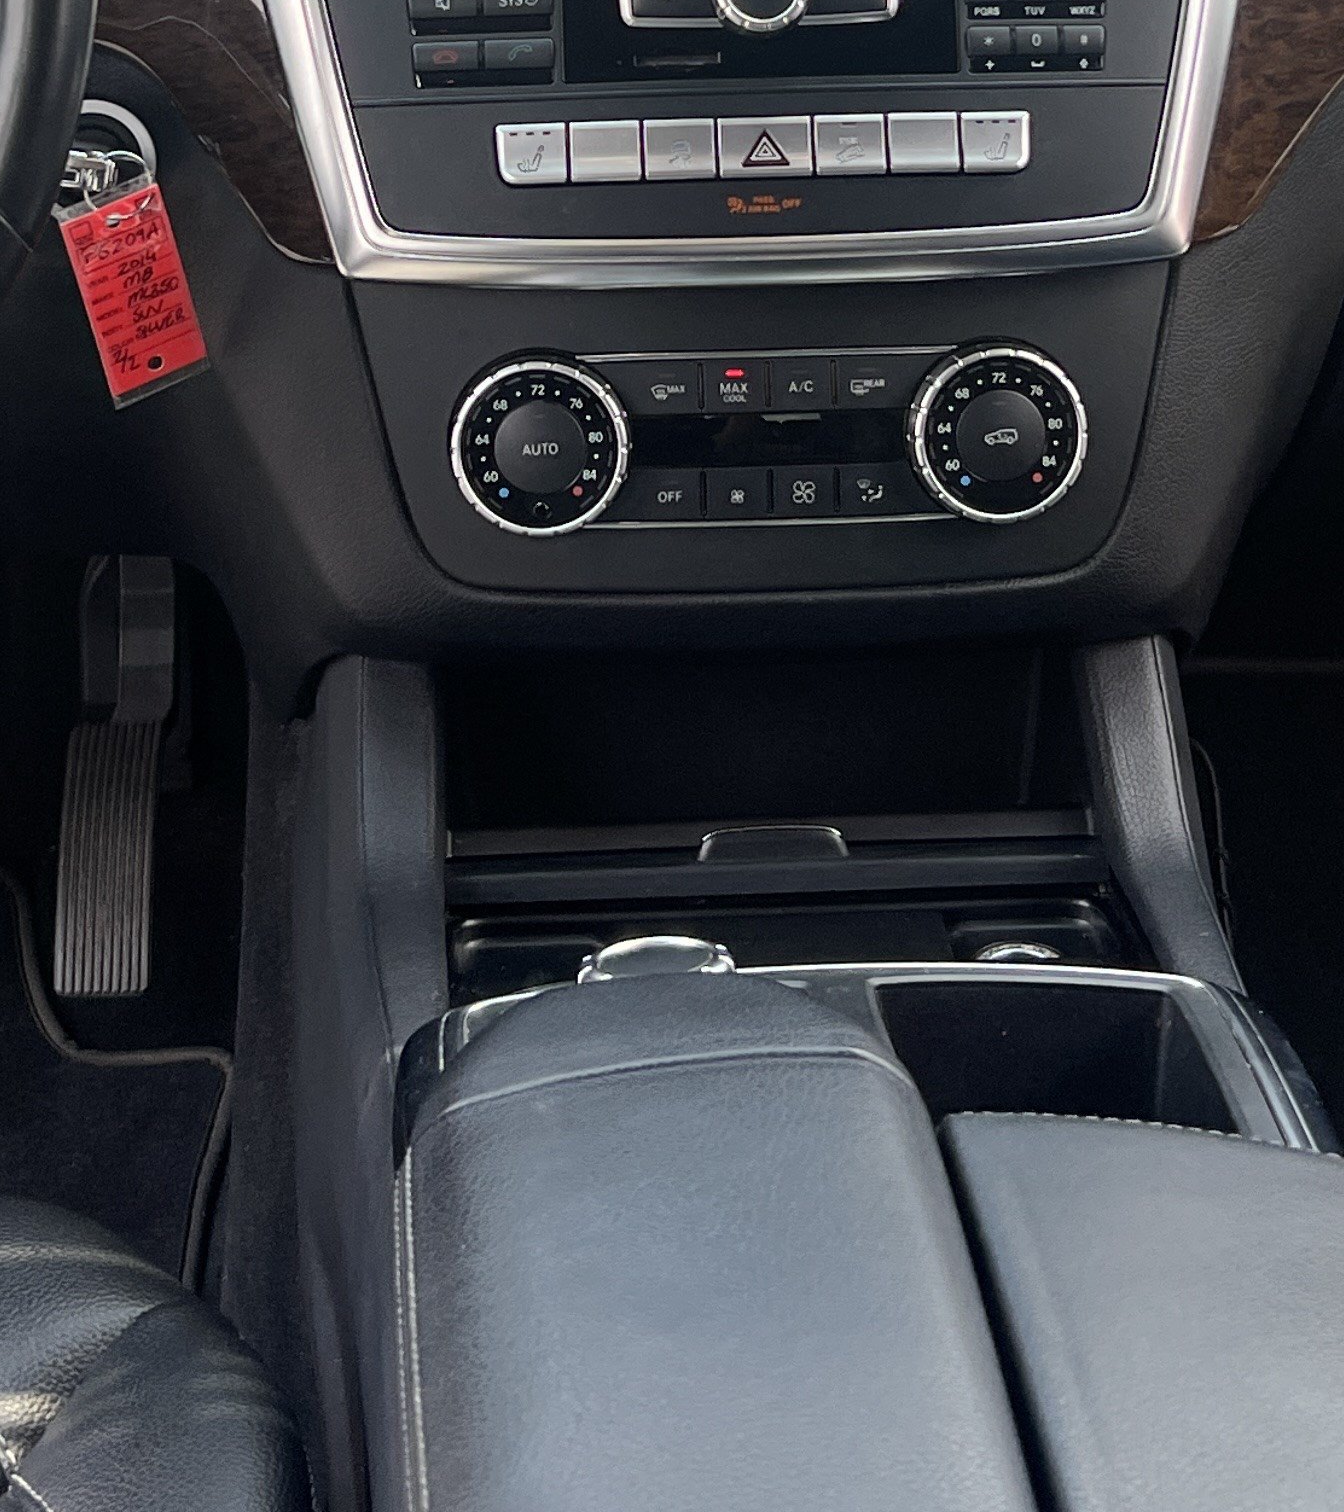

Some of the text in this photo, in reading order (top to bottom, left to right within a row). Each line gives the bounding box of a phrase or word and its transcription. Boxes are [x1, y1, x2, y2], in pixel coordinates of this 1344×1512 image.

[1024, 5, 1046, 17] TUV
[1069, 5, 1096, 16] WXYZ
[1030, 34, 1042, 48] 0
[863, 378, 885, 388] REAR
[991, 372, 1006, 384] 72
[530, 384, 546, 396] 72
[666, 384, 685, 395] MAX
[719, 382, 748, 395] MAX
[788, 380, 814, 393] A/C
[1029, 385, 1044, 397] 76
[954, 387, 970, 399] 68
[492, 398, 508, 411] 68
[569, 397, 584, 410] 76
[722, 395, 747, 404] COOL
[937, 422, 952, 434] 64
[1047, 418, 1063, 430] 80
[475, 434, 490, 446] 64
[588, 431, 604, 444] 80
[521, 443, 559, 456] AUTO
[944, 459, 960, 472] 60
[1041, 455, 1056, 468] 84
[483, 470, 499, 483] 60
[582, 468, 597, 481] 84
[657, 491, 683, 503] OFF
